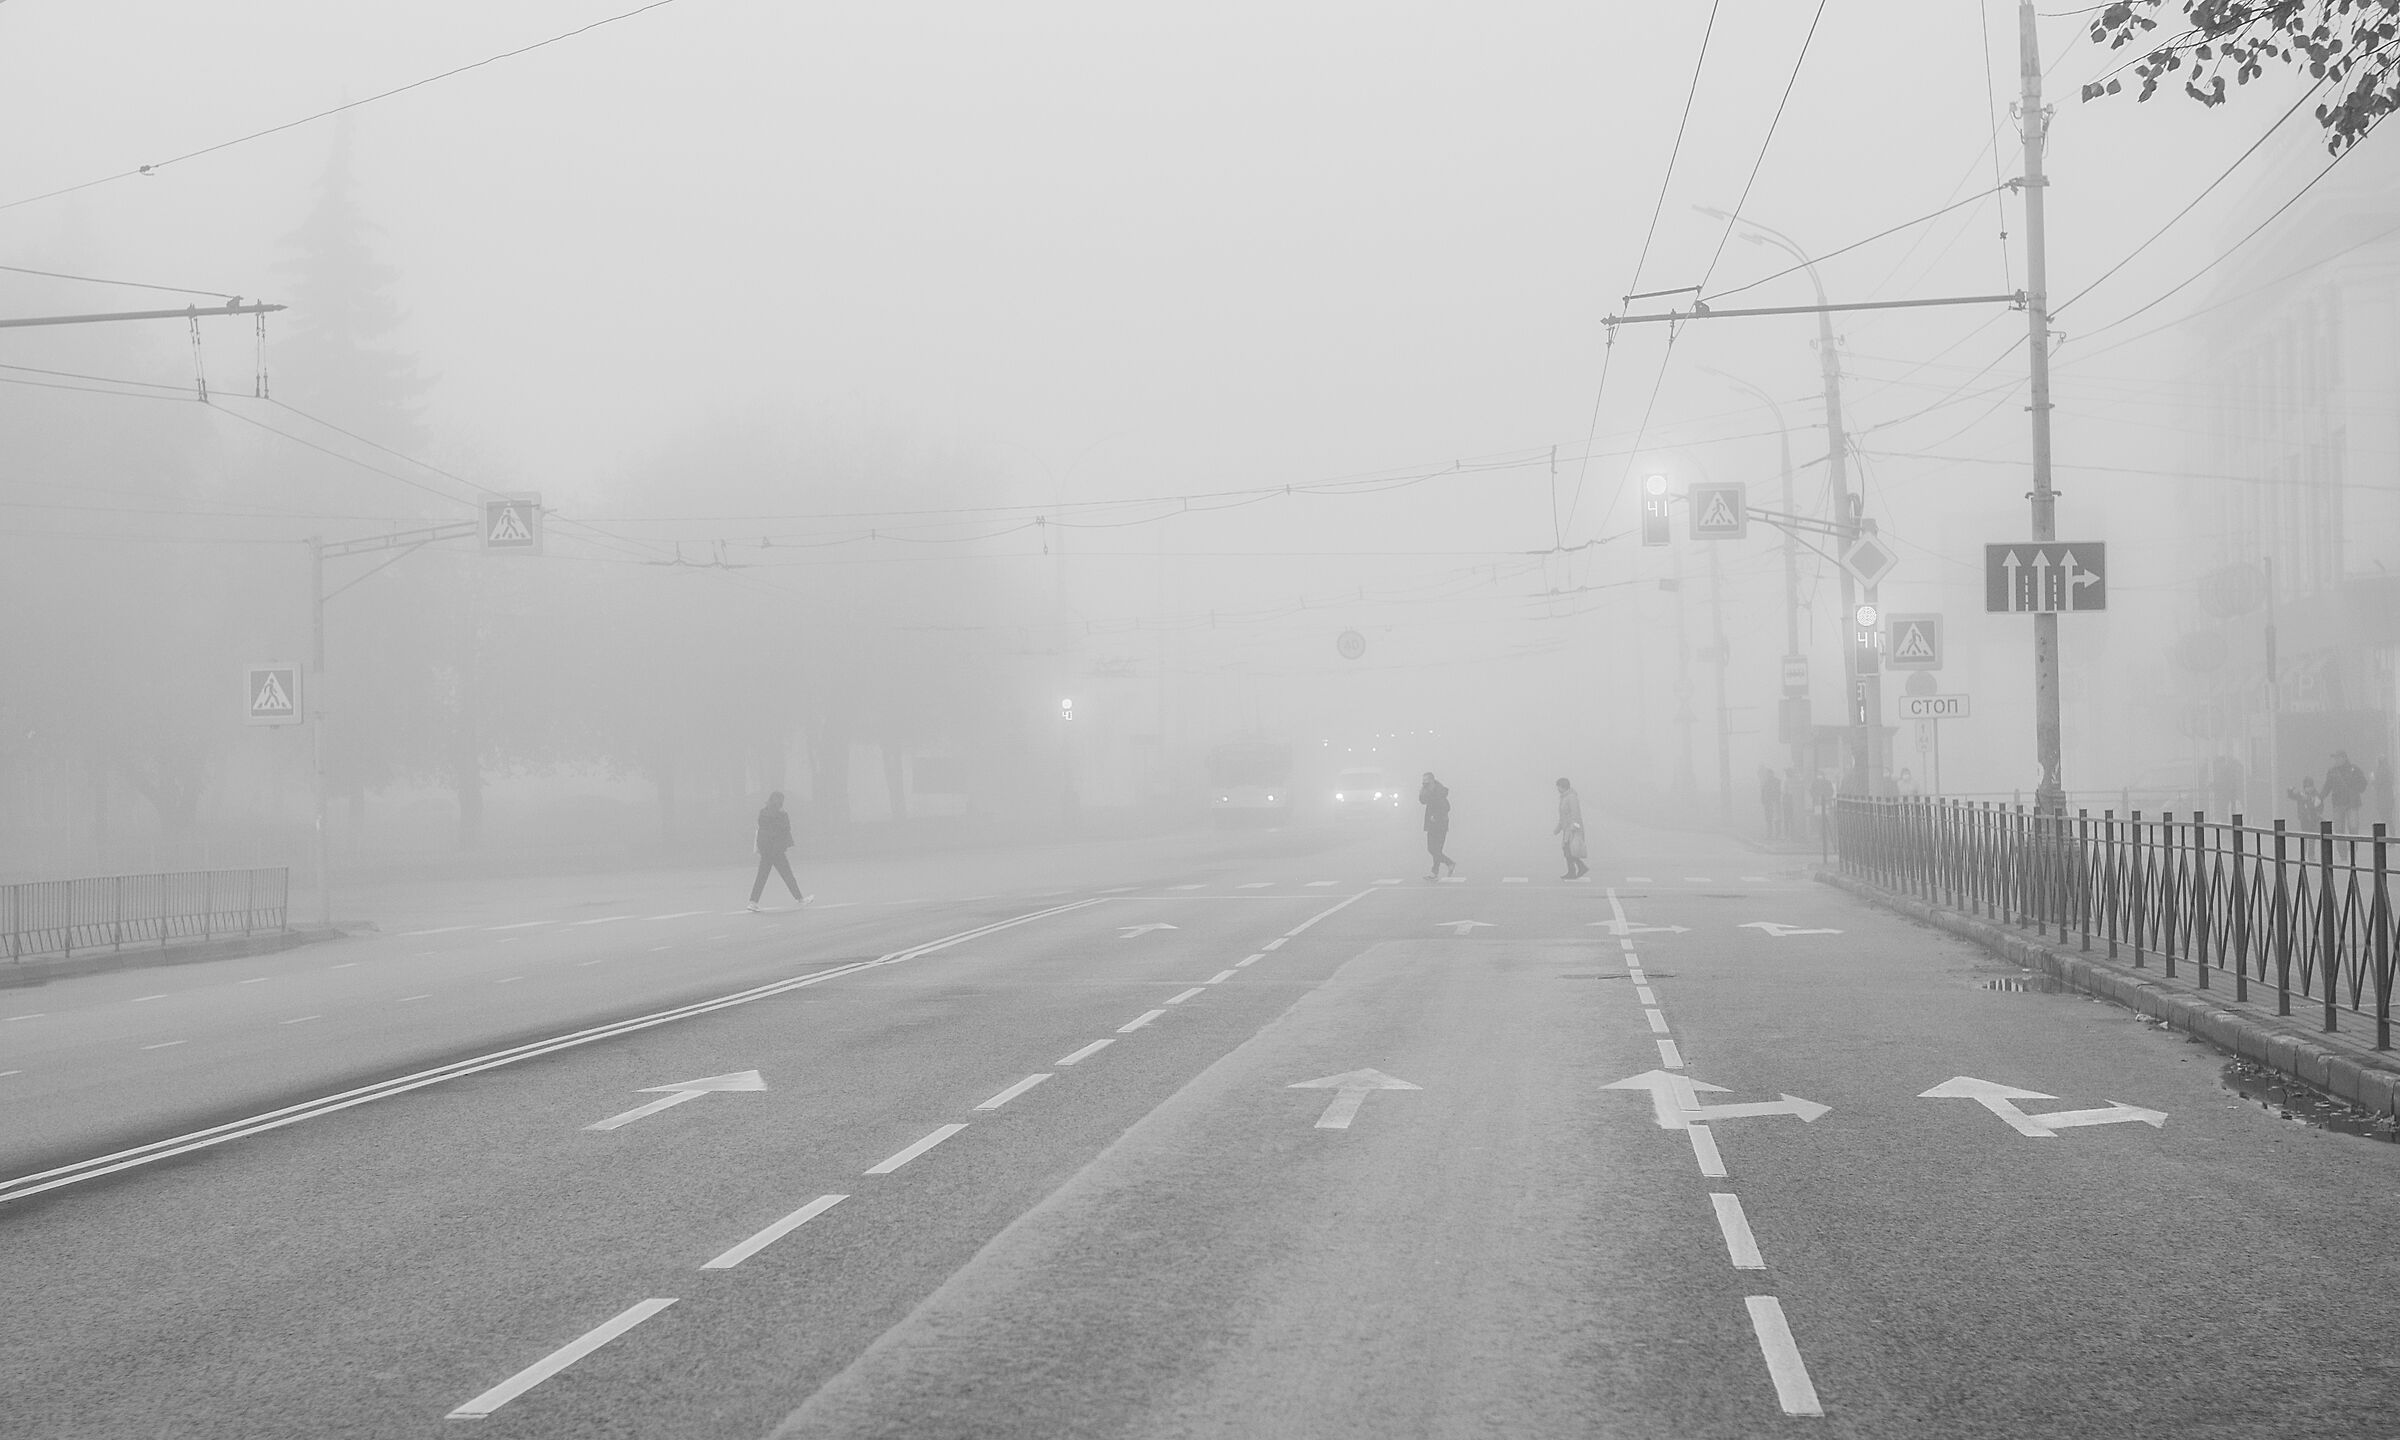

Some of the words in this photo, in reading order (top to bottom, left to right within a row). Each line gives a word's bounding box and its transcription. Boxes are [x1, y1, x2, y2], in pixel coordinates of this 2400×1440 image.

[1647, 500, 1667, 517] 41
[1858, 631, 1877, 648] 41
[1911, 699, 1958, 714] СТОП
[1062, 710, 1072, 720] 40
